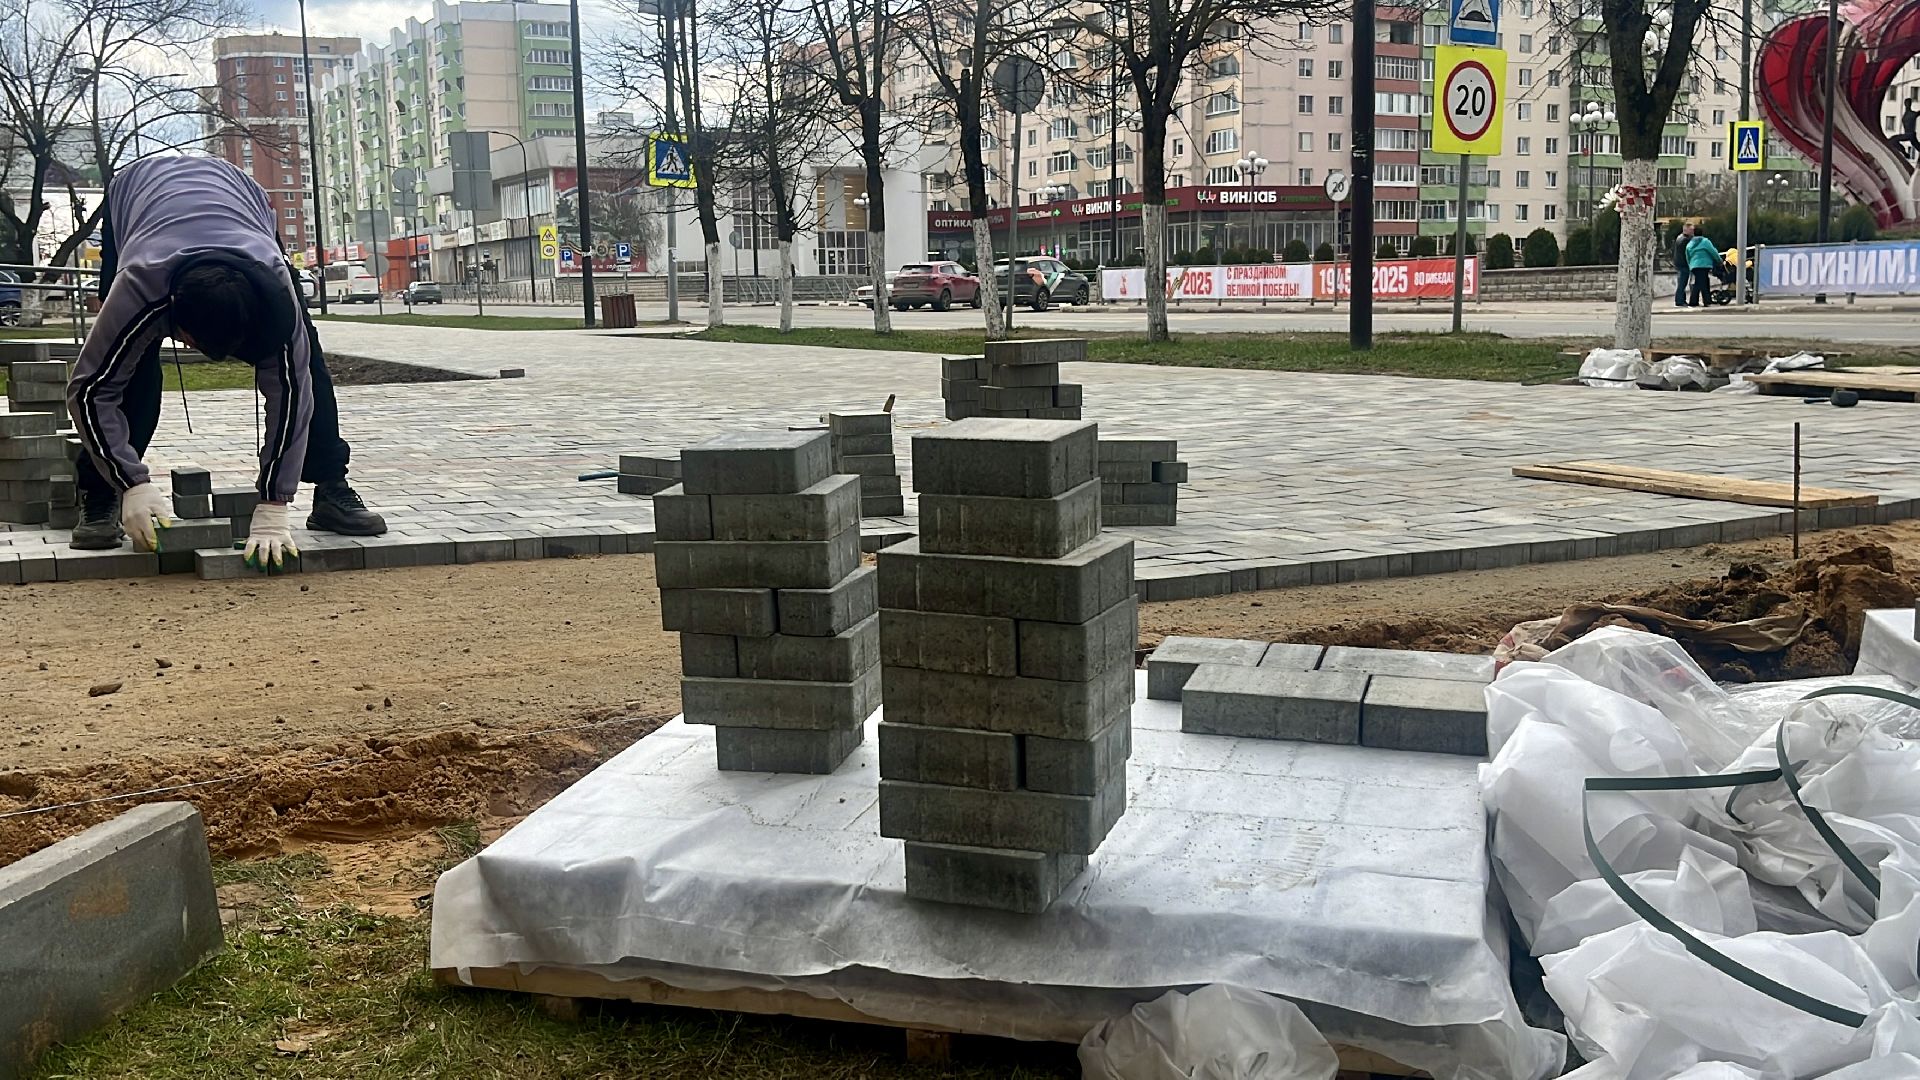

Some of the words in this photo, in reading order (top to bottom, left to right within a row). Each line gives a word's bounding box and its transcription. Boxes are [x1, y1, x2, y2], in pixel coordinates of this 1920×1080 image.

[1455, 84, 1486, 117] 20
[1332, 181, 1345, 193] 20
[934, 219, 973, 228] ОПТИКА
[563, 251, 571, 261] P
[619, 245, 628, 257] P
[1226, 268, 1232, 280] С
[1233, 265, 1287, 280] ПРАЗДНИКОМ
[1771, 248, 1918, 286] ПОМНИМ!
[1183, 271, 1213, 295] 2025
[1372, 266, 1408, 294] 2025
[1414, 271, 1425, 286] 80
[1226, 282, 1261, 297] ВЕЛИКОЙ
[1262, 282, 1300, 298] ПОБЕДЫ!
